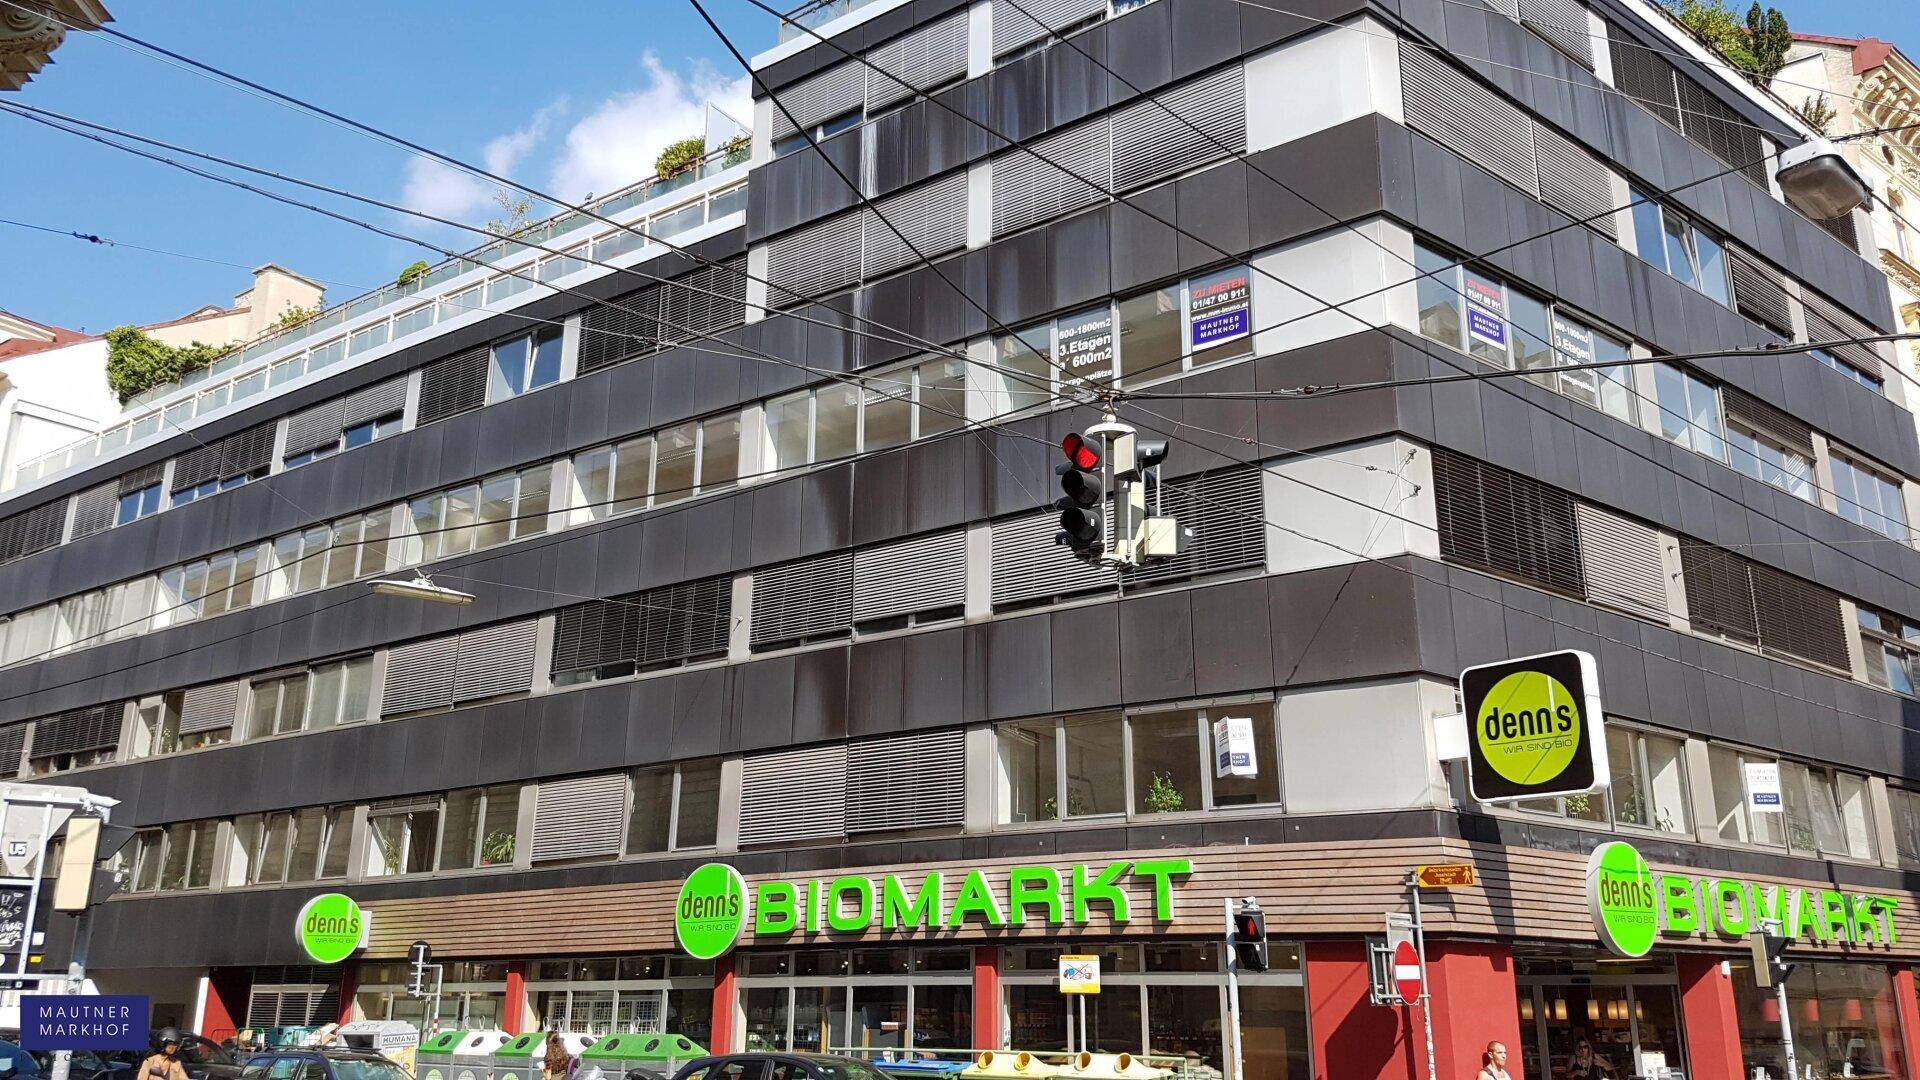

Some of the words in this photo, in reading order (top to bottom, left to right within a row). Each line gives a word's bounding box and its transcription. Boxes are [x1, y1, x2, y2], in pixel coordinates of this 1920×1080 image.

[1211, 277, 1246, 294] MIETEN
[1192, 295, 1216, 309] 01/47
[1217, 292, 1229, 302] 00
[1230, 288, 1246, 298] 911
[1200, 315, 1240, 331] MAUTNER
[1200, 323, 1240, 339] MARKHOF
[1059, 335, 1112, 357] 3.Etagen
[1072, 347, 1113, 368] 600m2
[1503, 745, 1524, 754] WIR
[1526, 741, 1552, 752] SIND
[1555, 739, 1573, 748] BIO
[755, 859, 1194, 935] BIOMARKT
[1662, 875, 1898, 945] BIOMARKT
[382, 1034, 416, 1044] HUMANA
